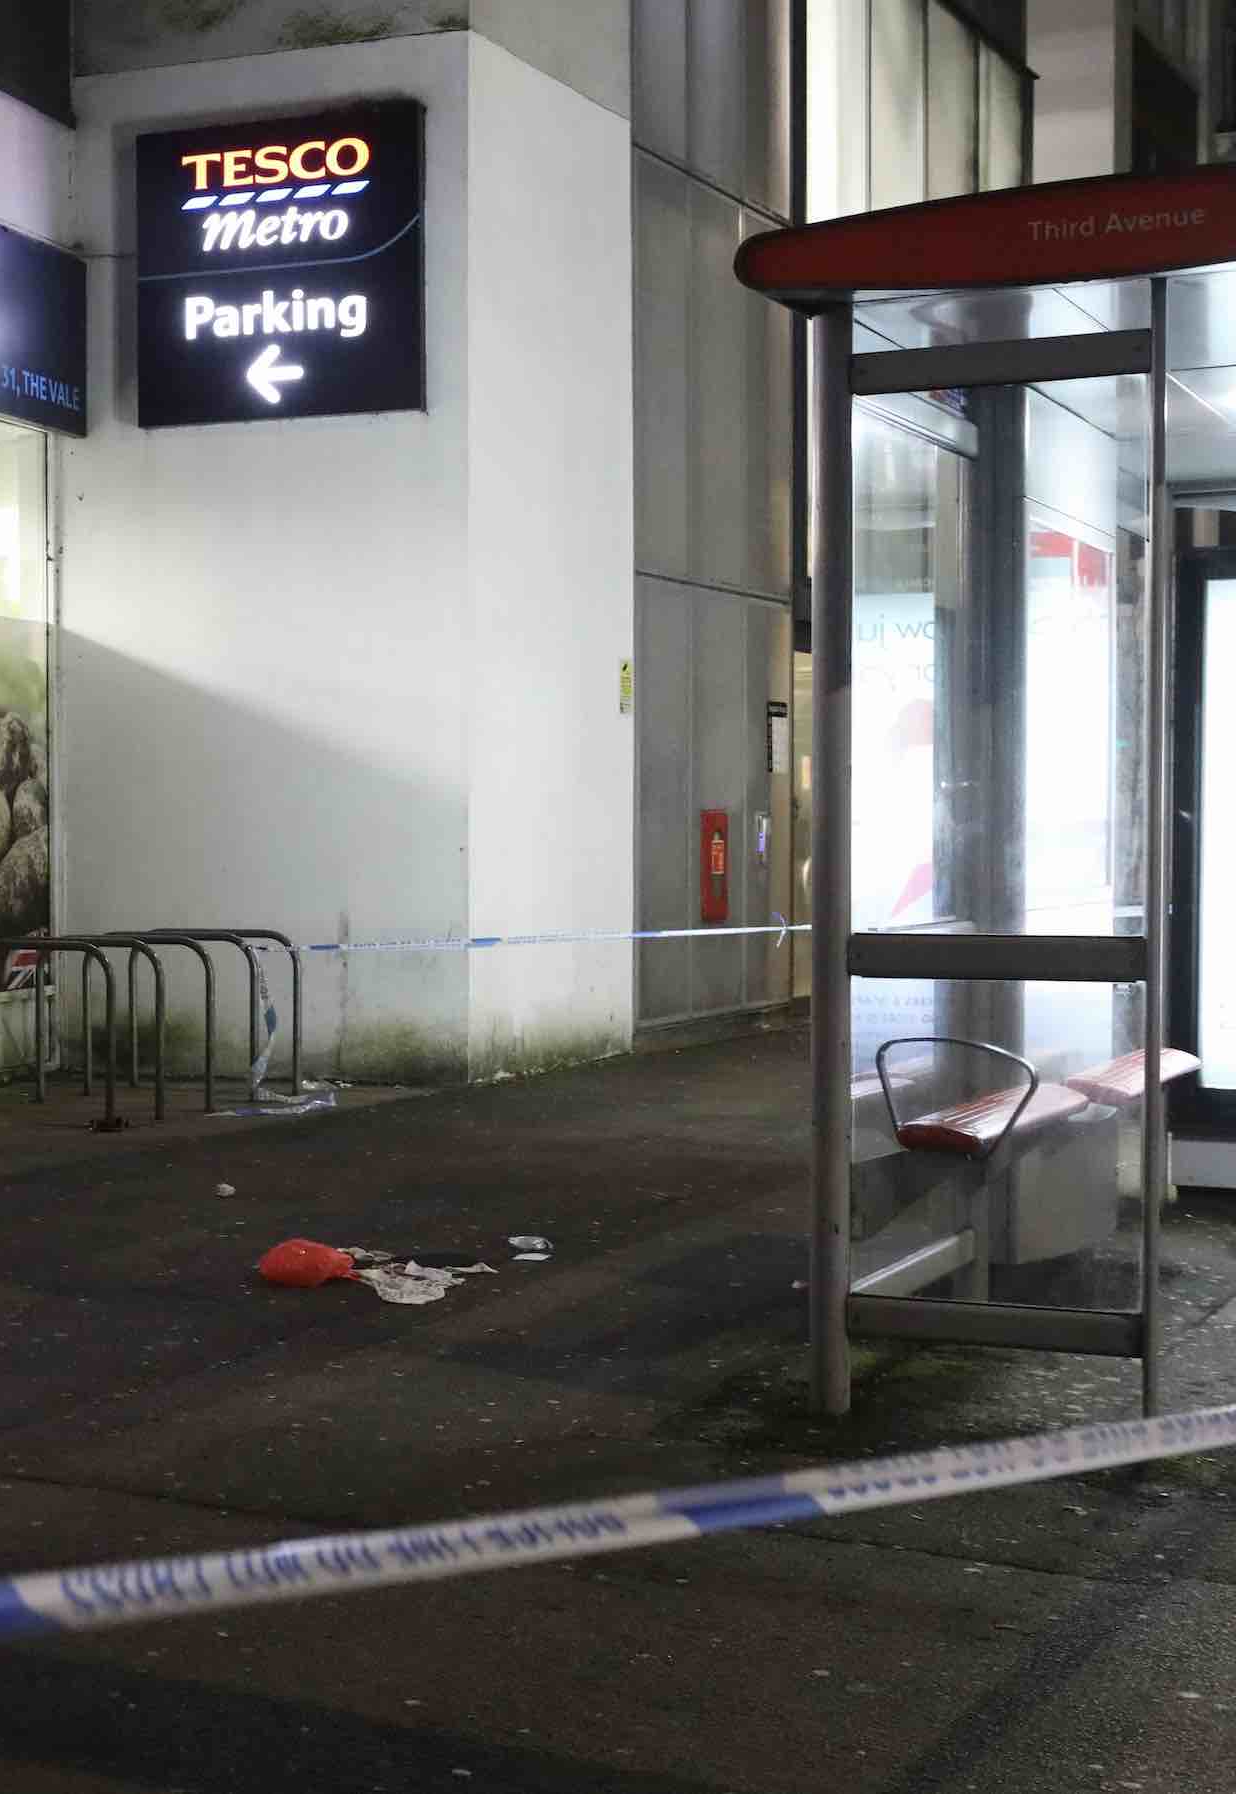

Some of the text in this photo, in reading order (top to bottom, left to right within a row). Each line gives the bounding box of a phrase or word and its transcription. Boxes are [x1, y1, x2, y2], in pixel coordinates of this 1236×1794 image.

[181, 137, 370, 190] TESCO
[201, 206, 349, 252] Metro
[1028, 207, 1206, 241] Third Avenue
[184, 288, 368, 340] Parking
[21, 369, 47, 402] THE
[48, 379, 80, 411] VALE
